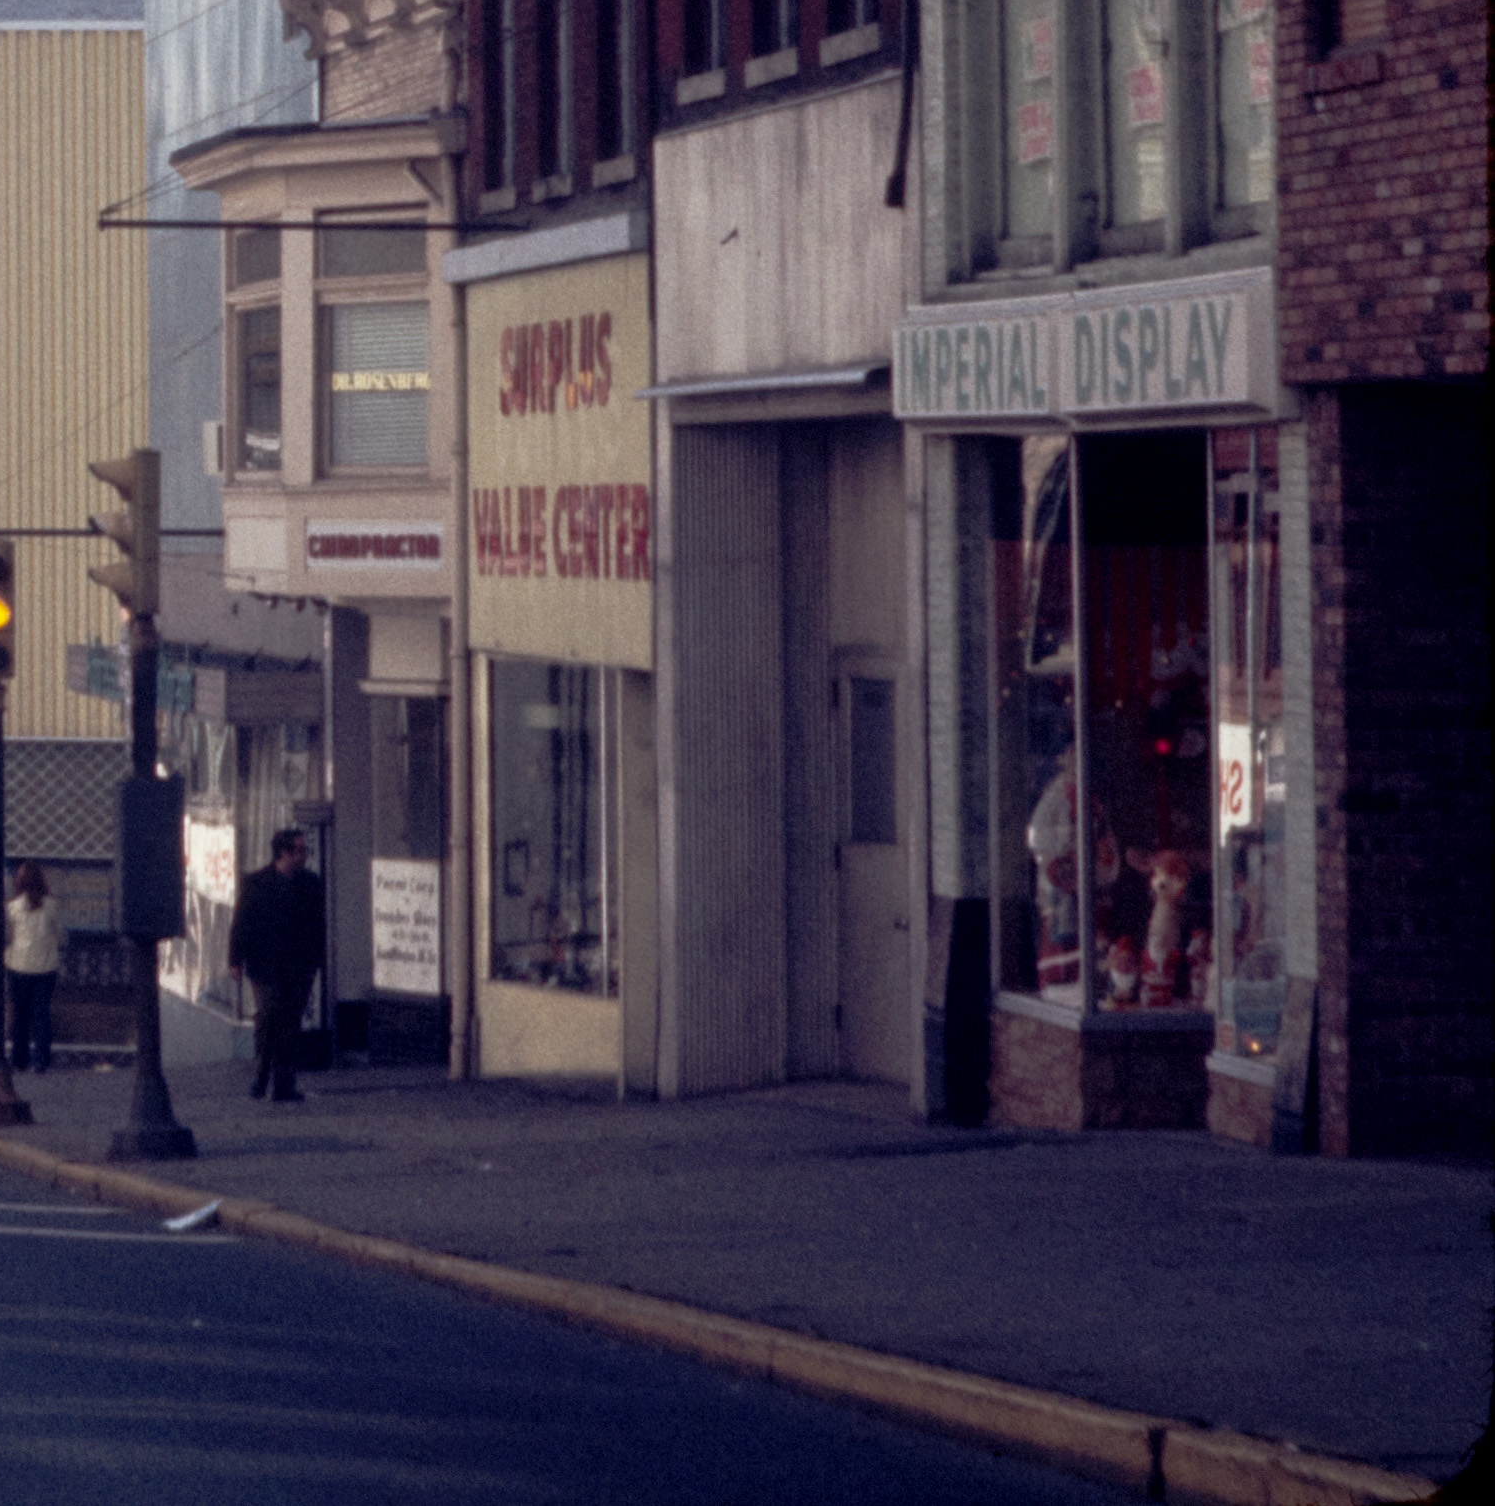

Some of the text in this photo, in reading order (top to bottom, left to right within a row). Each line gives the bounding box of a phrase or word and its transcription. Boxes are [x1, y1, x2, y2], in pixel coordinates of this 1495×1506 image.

[499, 312, 613, 417] SURPLUS
[898, 299, 1233, 413] IMPERIAL DISPLAY
[474, 482, 651, 582] VALUE CENTER
